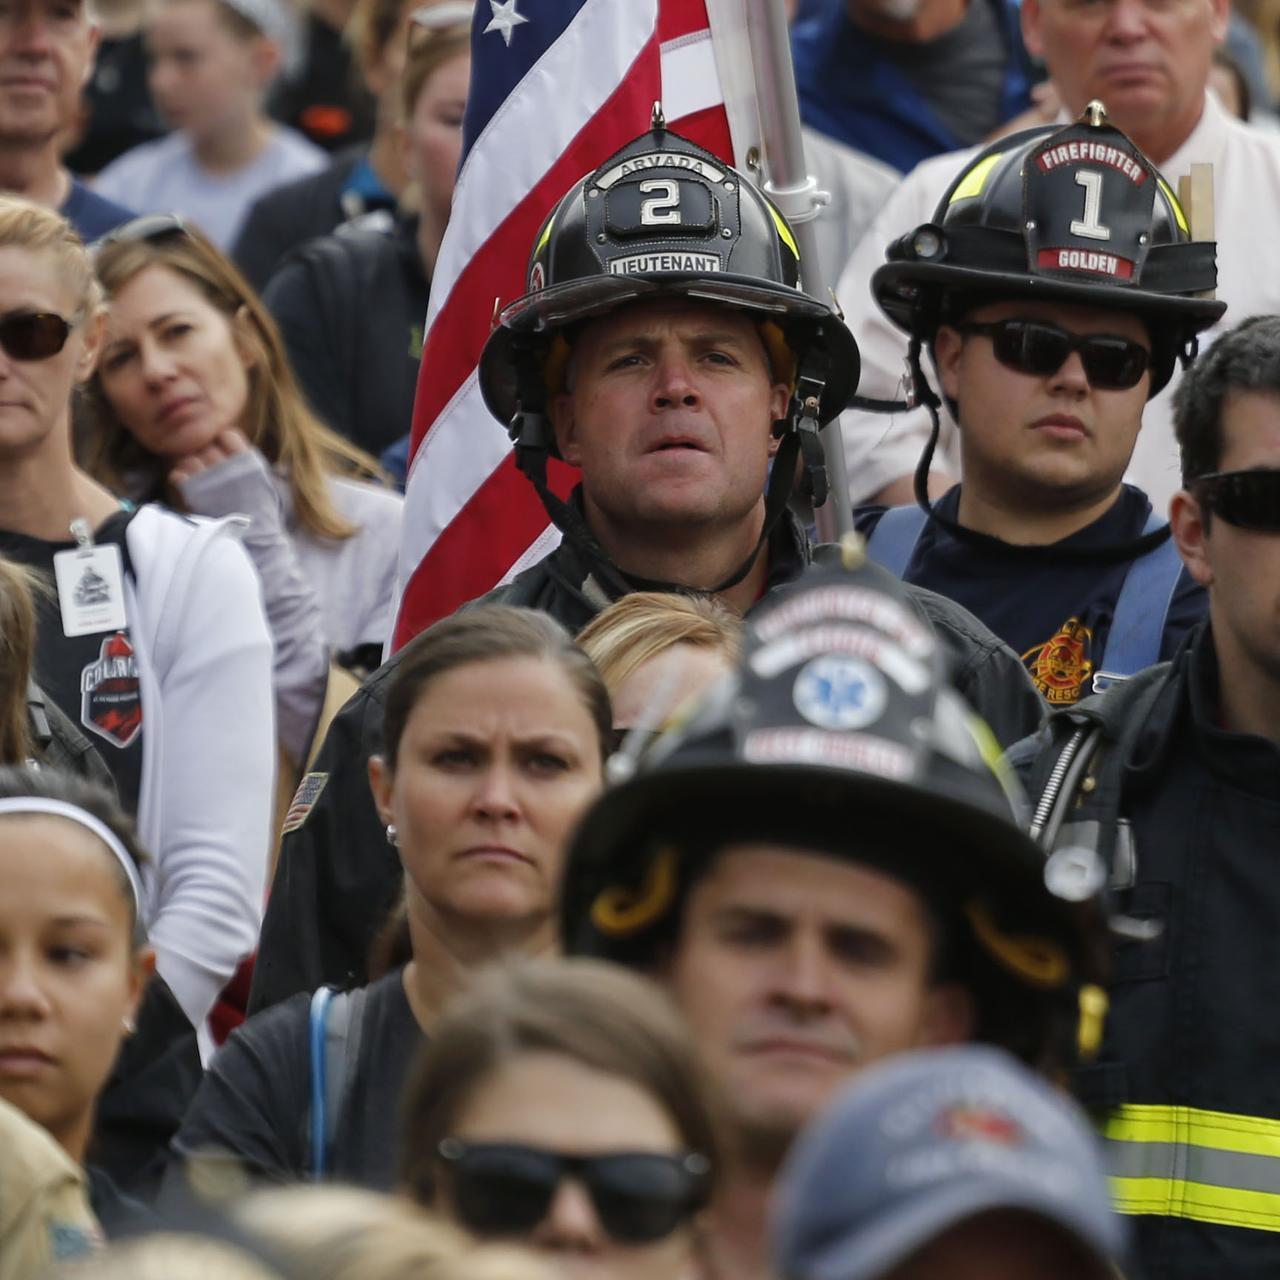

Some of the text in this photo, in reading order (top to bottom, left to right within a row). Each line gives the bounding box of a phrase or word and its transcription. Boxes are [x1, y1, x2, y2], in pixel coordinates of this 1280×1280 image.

[620, 155, 705, 174] ARVADA
[1041, 142, 1144, 181] FIREFIGHTER
[639, 179, 682, 225] 2
[1070, 170, 1110, 241] 1
[612, 255, 718, 274] LIEUTENANT
[1058, 250, 1118, 275] GOLDEN
